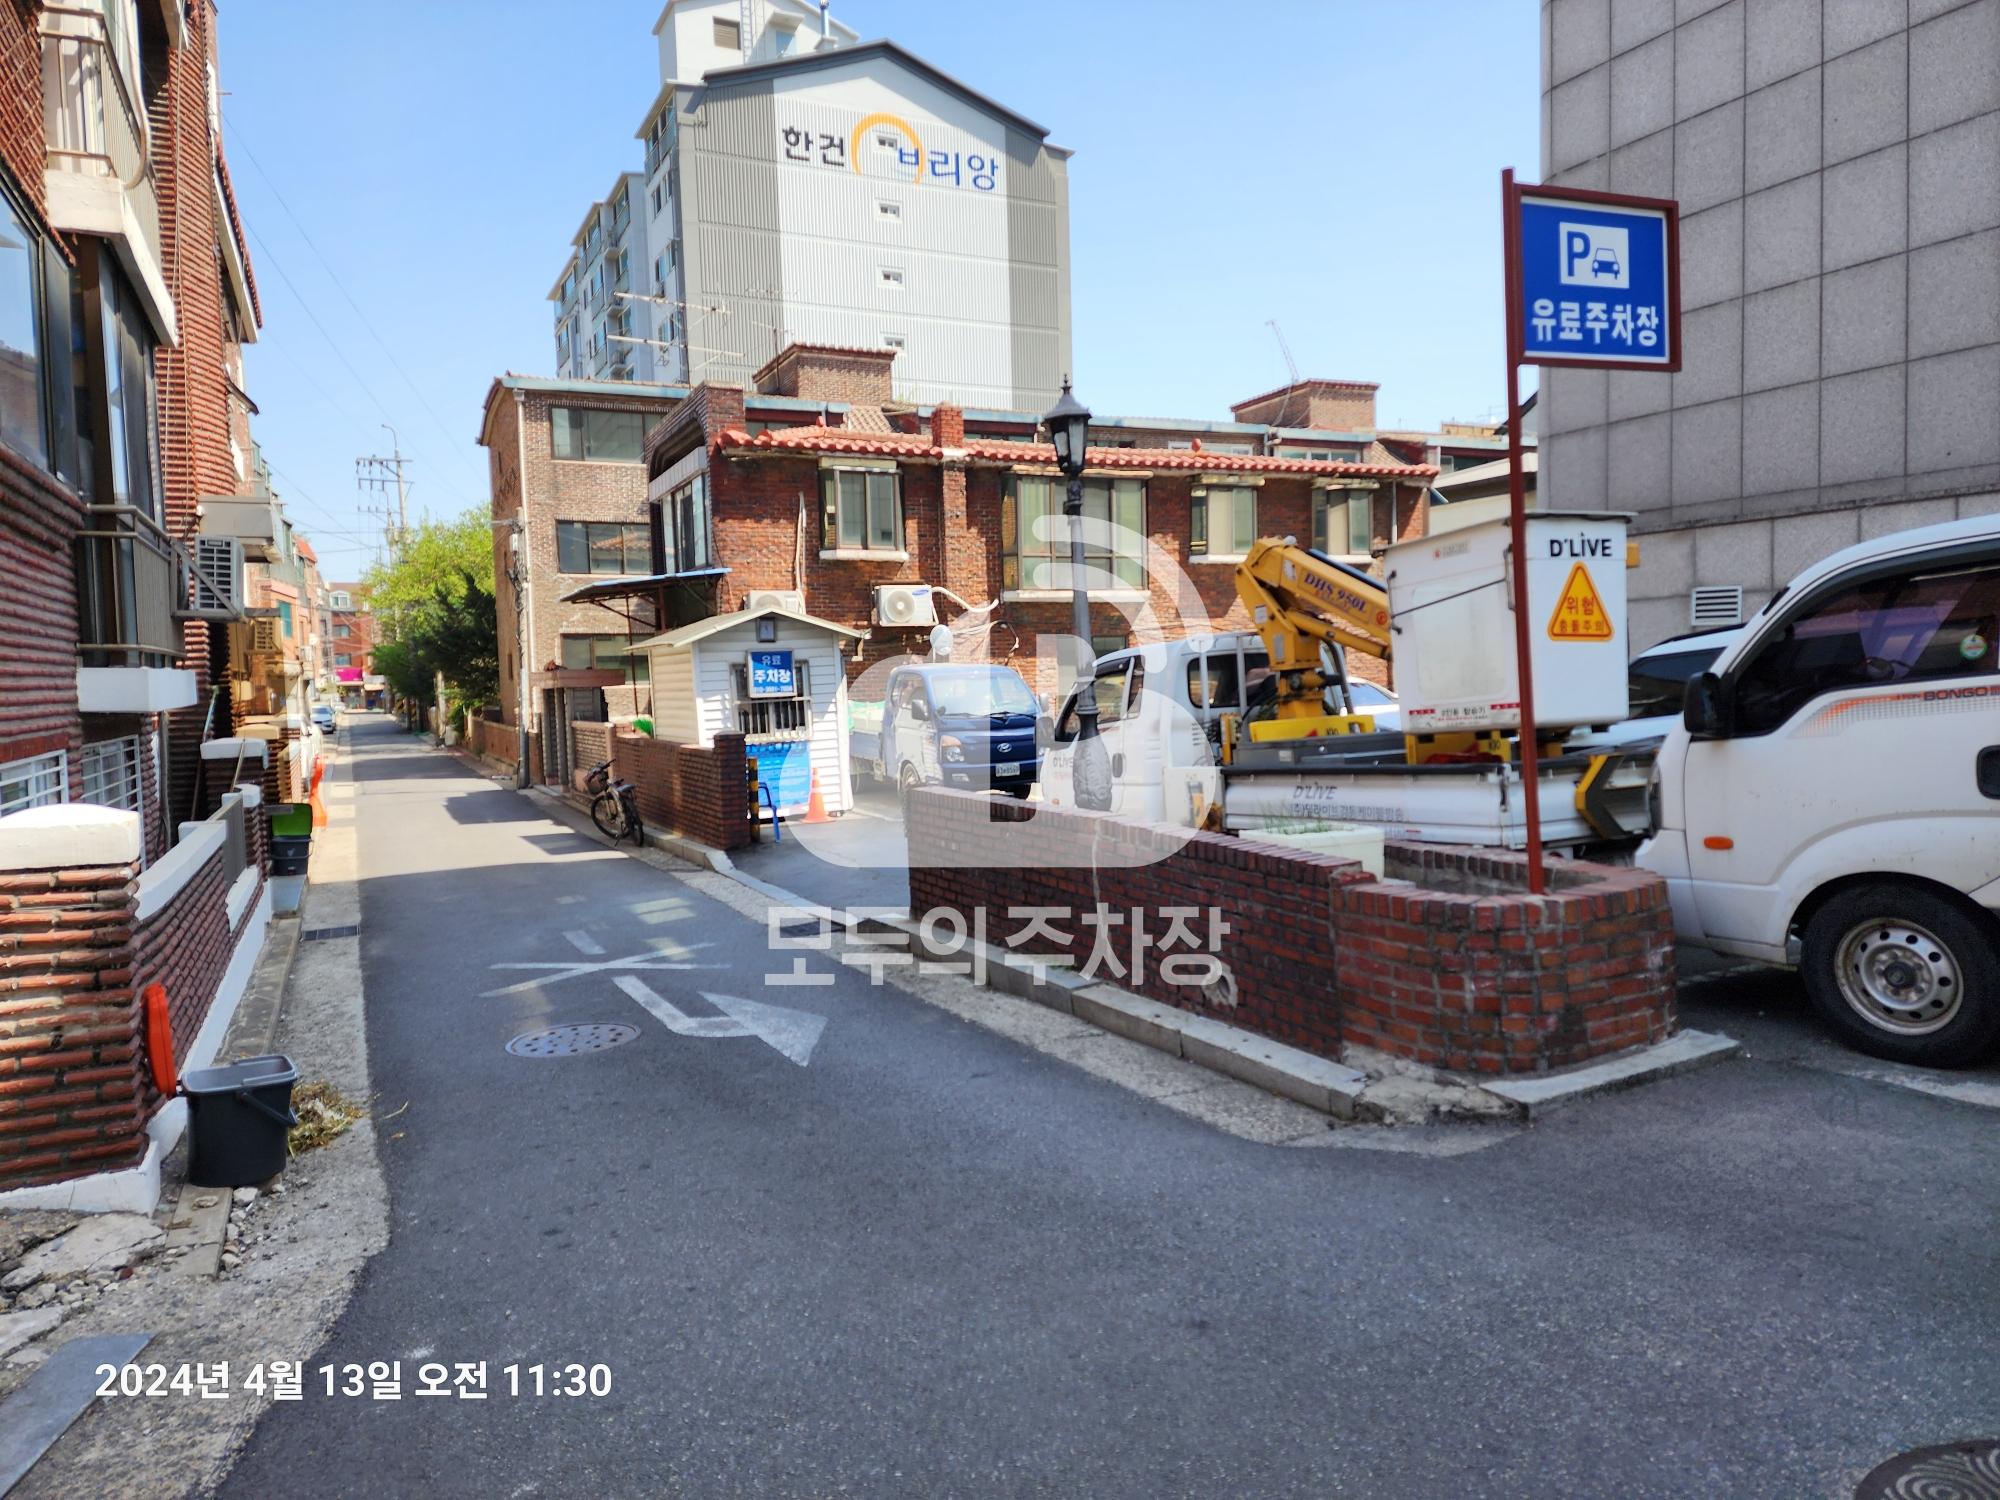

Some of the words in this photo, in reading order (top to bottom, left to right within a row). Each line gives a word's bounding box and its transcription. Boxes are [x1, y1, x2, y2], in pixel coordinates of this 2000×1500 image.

[782, 126, 844, 167] 한건
[1566, 230, 1591, 277] P
[1532, 298, 1660, 347] 유료주차장
[1549, 532, 1613, 557] D'LIVE
[1566, 595, 1595, 616] 위험
[761, 655, 781, 666] 유료
[754, 668, 791, 684] 주차장
[1923, 686, 1988, 701] BONGO
